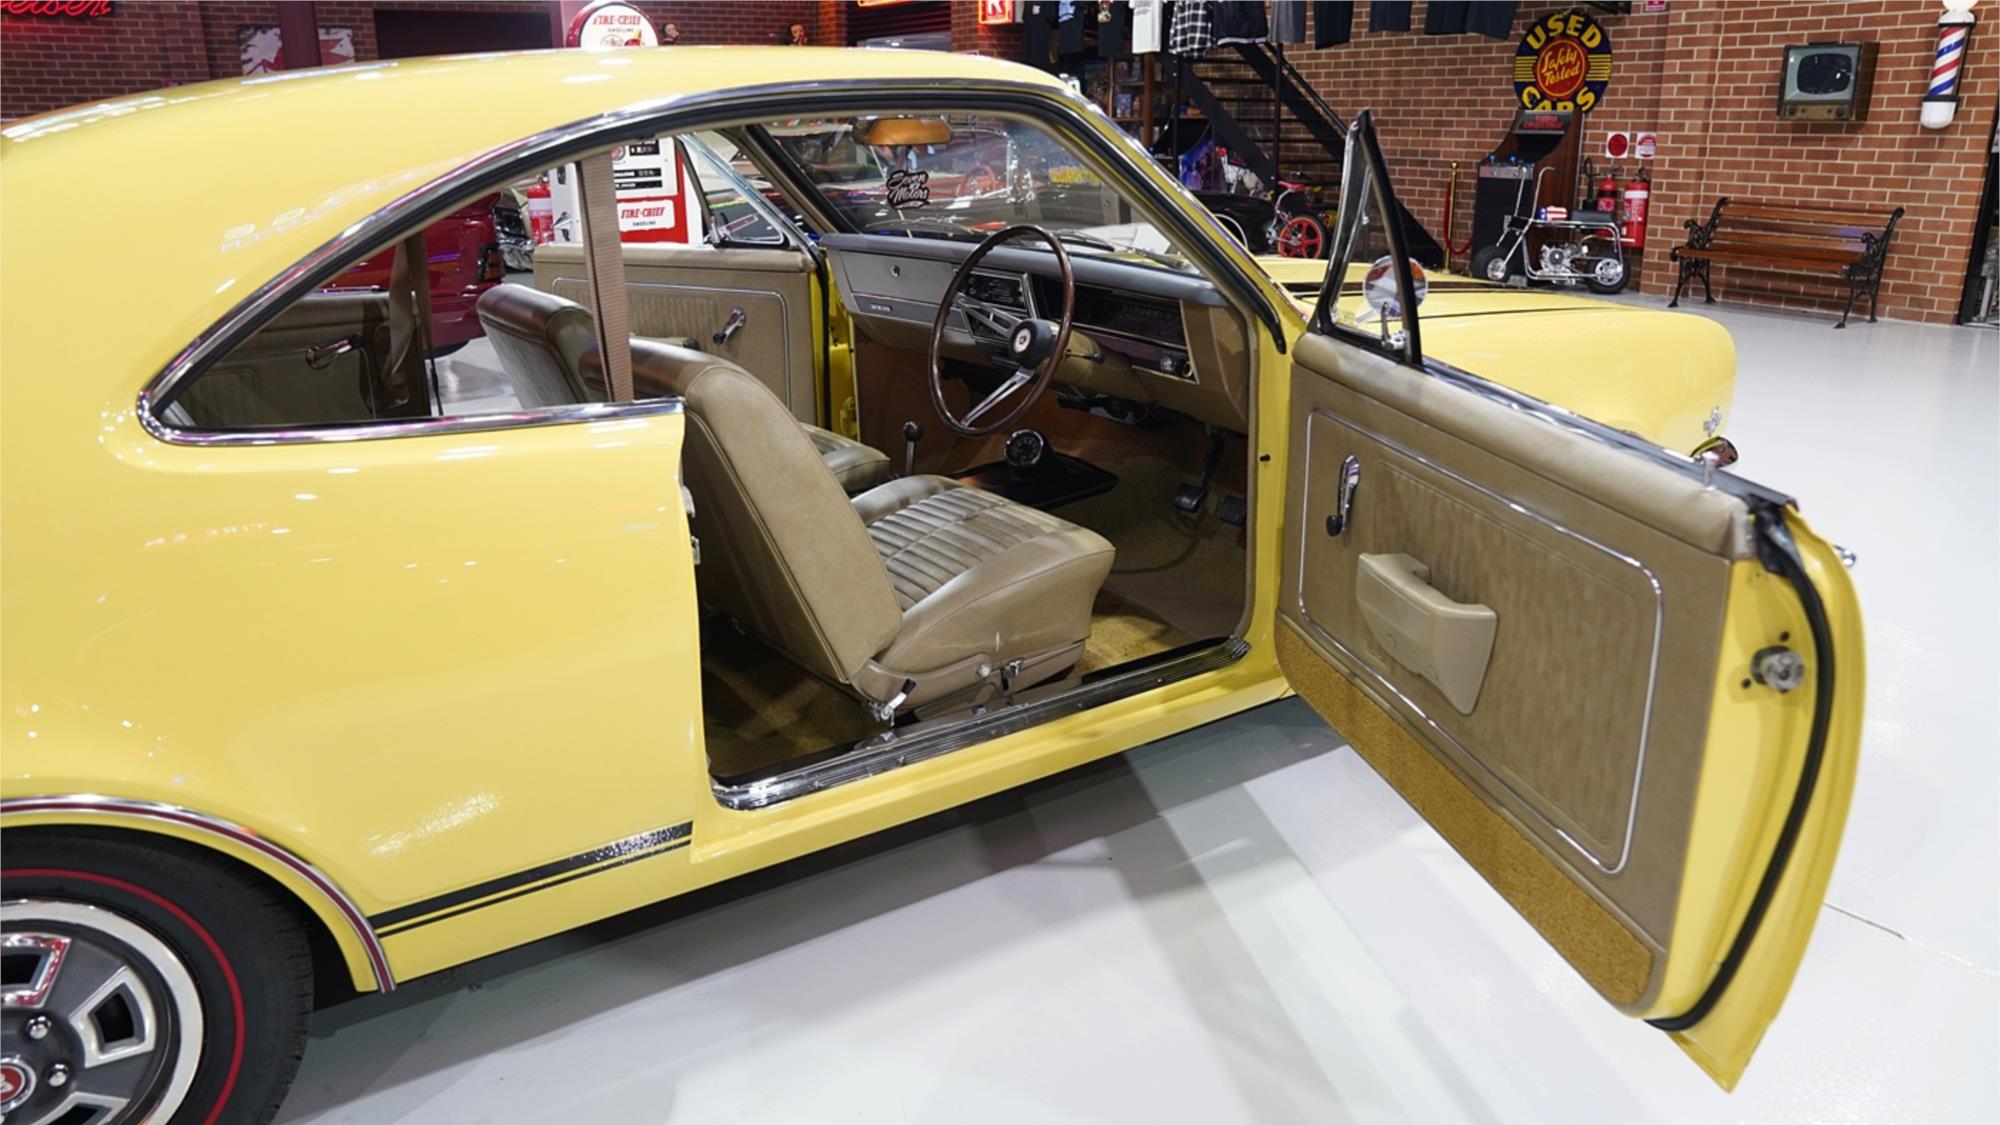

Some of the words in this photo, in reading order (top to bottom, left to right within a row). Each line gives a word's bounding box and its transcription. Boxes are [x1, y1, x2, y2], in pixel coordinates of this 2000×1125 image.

[1526, 14, 1602, 49] USED
[1541, 47, 1577, 74] Safety
[1544, 60, 1580, 87] Tested
[887, 172, 926, 191] Seven
[889, 187, 928, 204] Motors
[621, 207, 666, 219] FIRE-CHIEF
